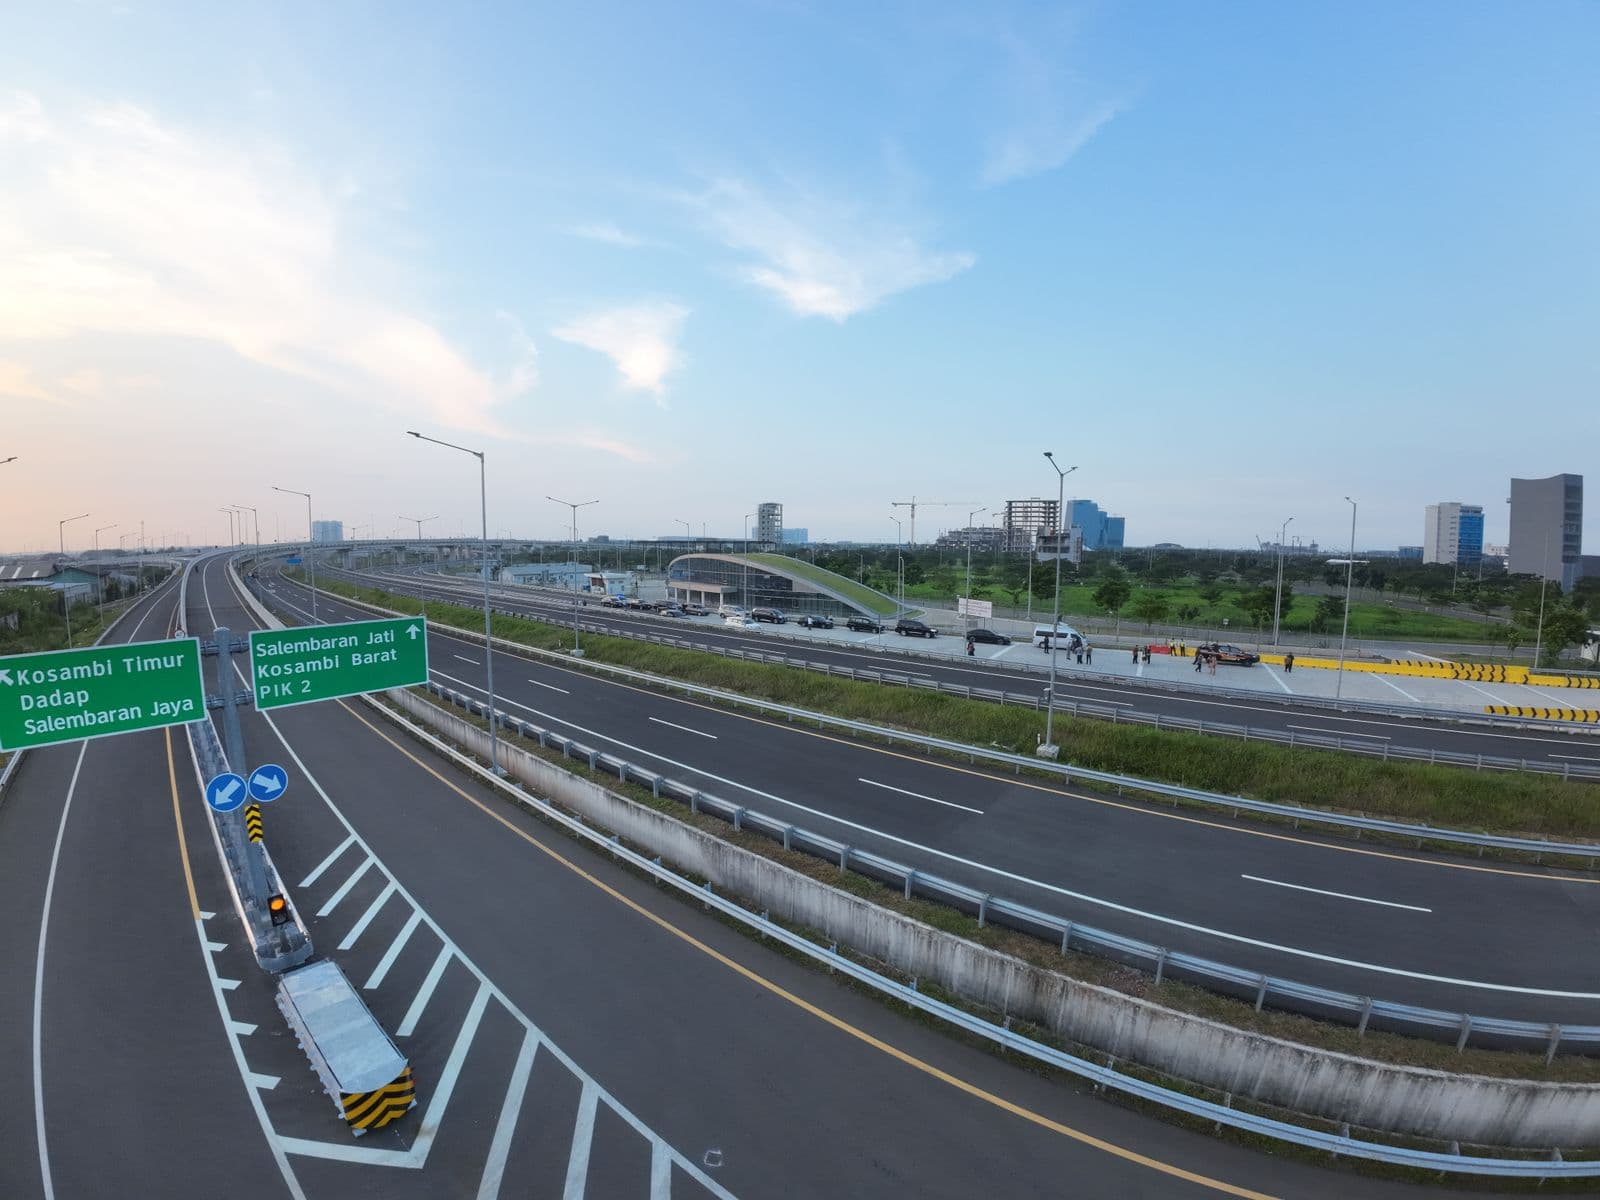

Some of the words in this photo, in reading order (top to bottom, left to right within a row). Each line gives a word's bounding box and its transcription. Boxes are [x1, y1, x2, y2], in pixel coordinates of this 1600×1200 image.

[256, 634, 359, 658] Salembaran
[365, 629, 395, 646] Jati
[16, 656, 113, 687] Kosambi
[122, 654, 186, 674] Timur
[257, 655, 340, 679] Kosambi
[351, 648, 398, 666] Barat
[19, 688, 90, 712] Dadap
[259, 682, 293, 700] PIK
[300, 680, 312, 694] 2
[23, 708, 143, 736] Salembaran
[149, 697, 195, 718] Jaya
